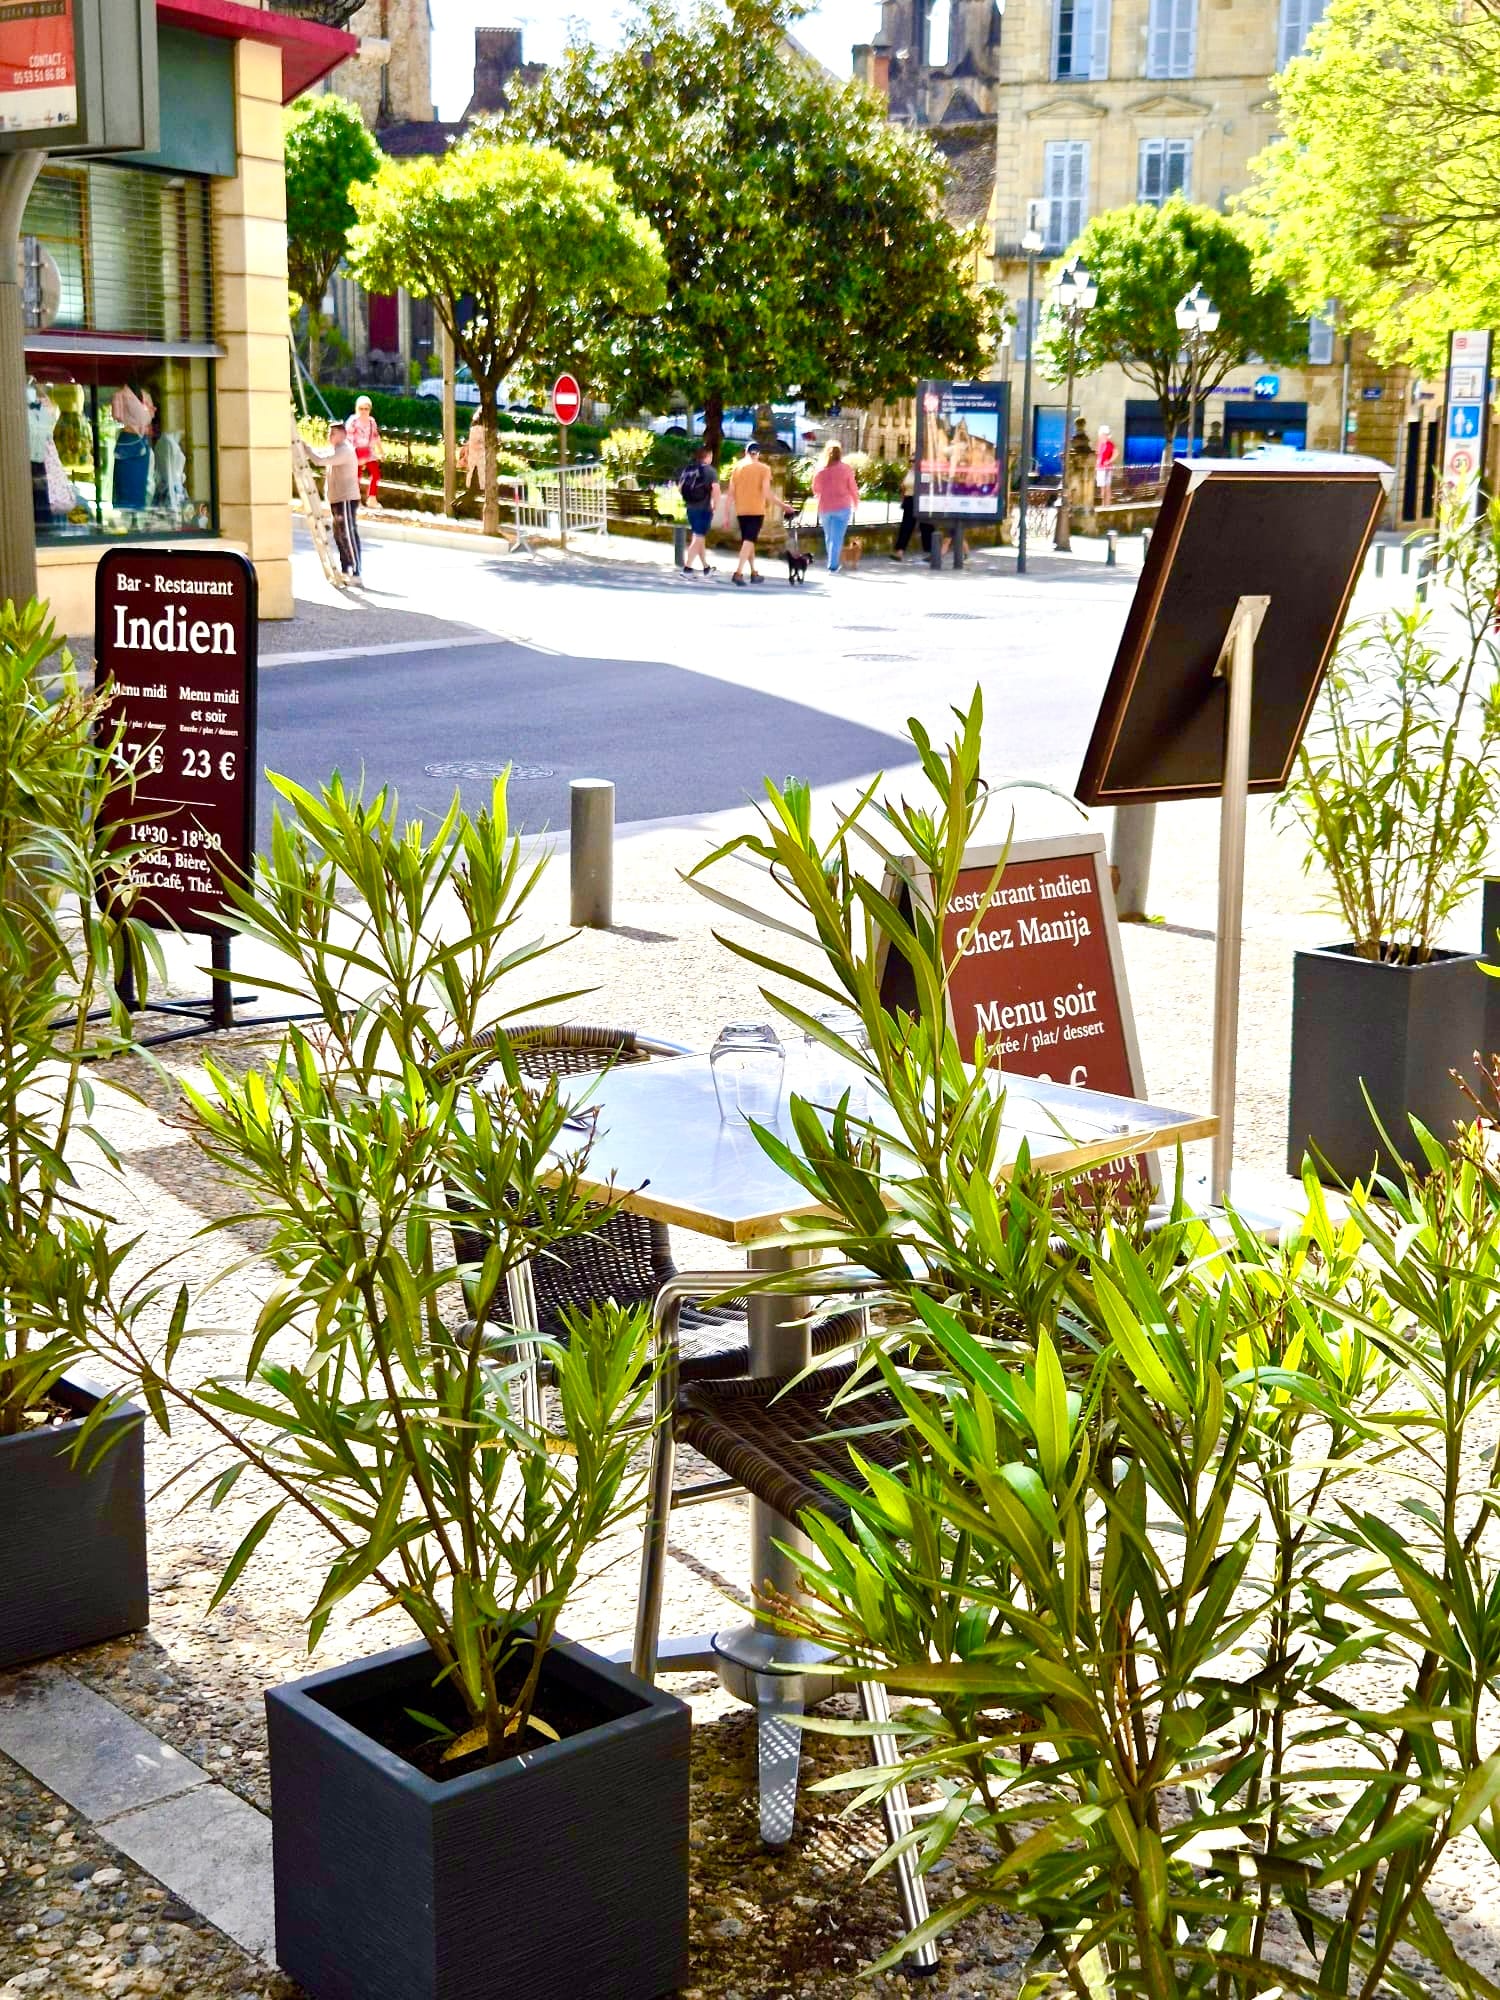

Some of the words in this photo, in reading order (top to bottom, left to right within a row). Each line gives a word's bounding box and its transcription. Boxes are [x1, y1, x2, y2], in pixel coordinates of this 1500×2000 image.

[29, 52, 62, 68] CONTACT
[117, 573, 141, 592] Bar
[154, 574, 234, 596] Restaurant
[113, 604, 237, 656] Indien
[142, 684, 168, 699] midi
[179, 686, 211, 702] Menu
[214, 689, 240, 705] midi
[191, 710, 202, 722] et
[205, 709, 228, 723] soir
[114, 742, 142, 771] 17
[181, 748, 212, 778] 23
[219, 751, 236, 781] €
[175, 852, 211, 873] Bière,
[154, 872, 185, 892] Café,
[188, 877, 224, 895] Thé...
[1039, 874, 1092, 900] indien
[956, 926, 1014, 956] Chez
[1017, 910, 1091, 947] Manija
[974, 998, 1048, 1035] Menu
[1053, 983, 1097, 1020] soir
[982, 1035, 1020, 1058] ntrée
[1063, 1021, 1104, 1042] dessert
[1108, 1157, 1126, 1176] 10
